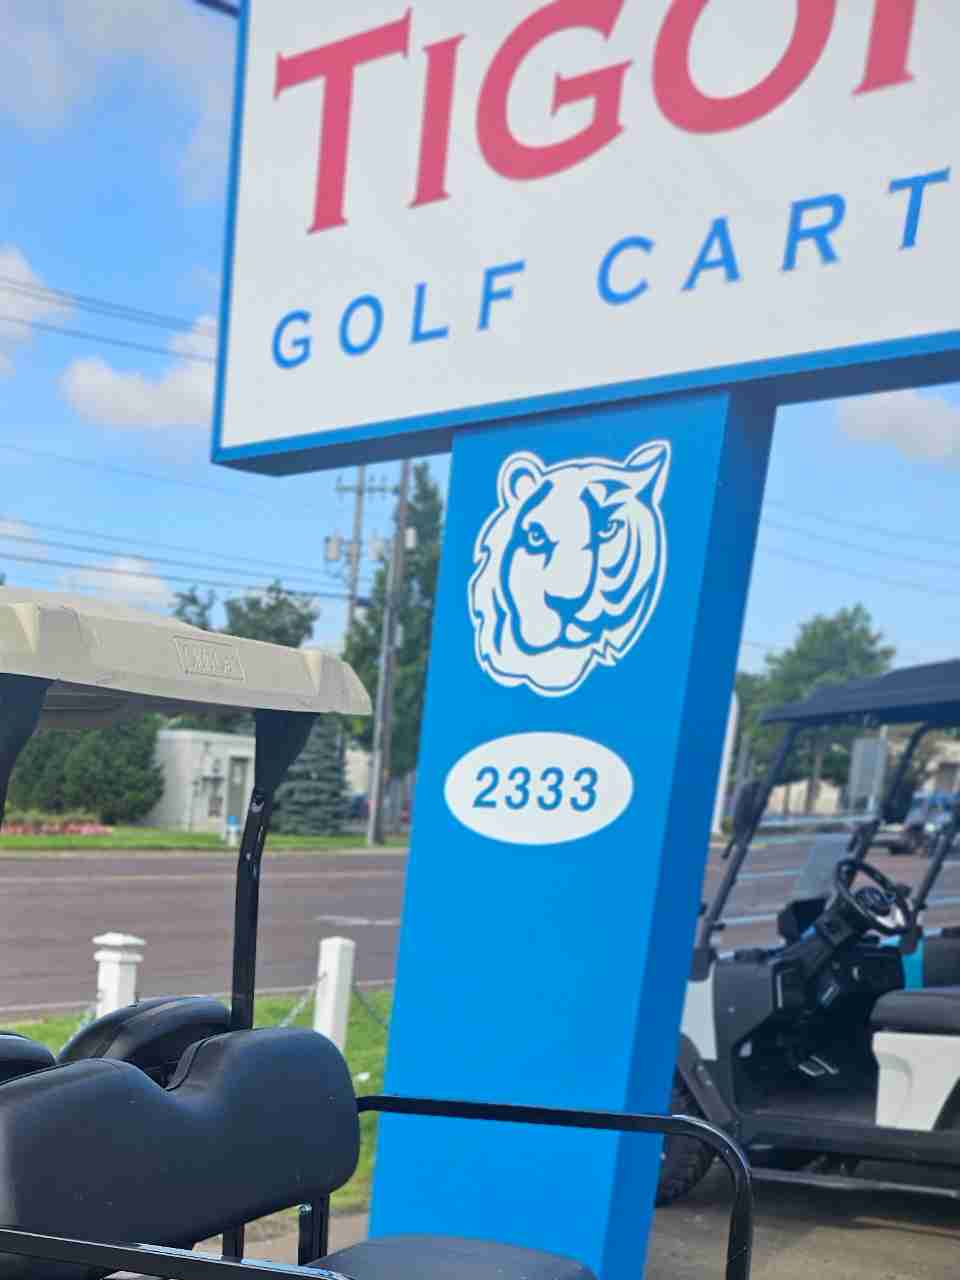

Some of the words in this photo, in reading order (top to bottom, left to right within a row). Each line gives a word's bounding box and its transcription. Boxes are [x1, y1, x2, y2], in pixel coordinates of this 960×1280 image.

[271, 261, 526, 369] GOLF
[597, 167, 951, 305] CART
[472, 766, 598, 812] 2333
